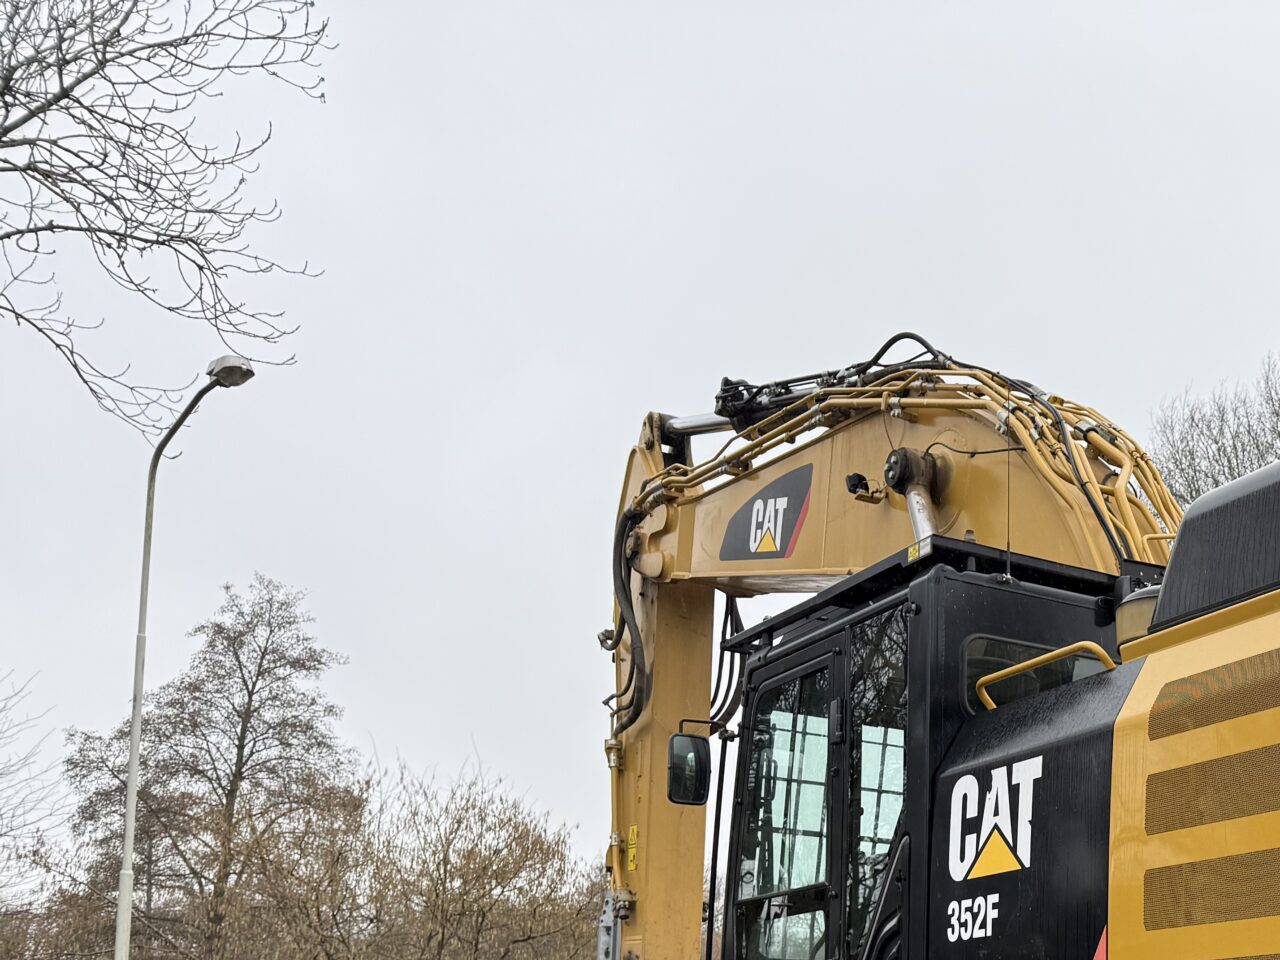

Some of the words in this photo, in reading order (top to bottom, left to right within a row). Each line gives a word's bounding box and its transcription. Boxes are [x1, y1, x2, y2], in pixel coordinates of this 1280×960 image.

[749, 497, 788, 553] CAT
[949, 756, 1043, 882] CAT
[947, 893, 1000, 943] 352F
